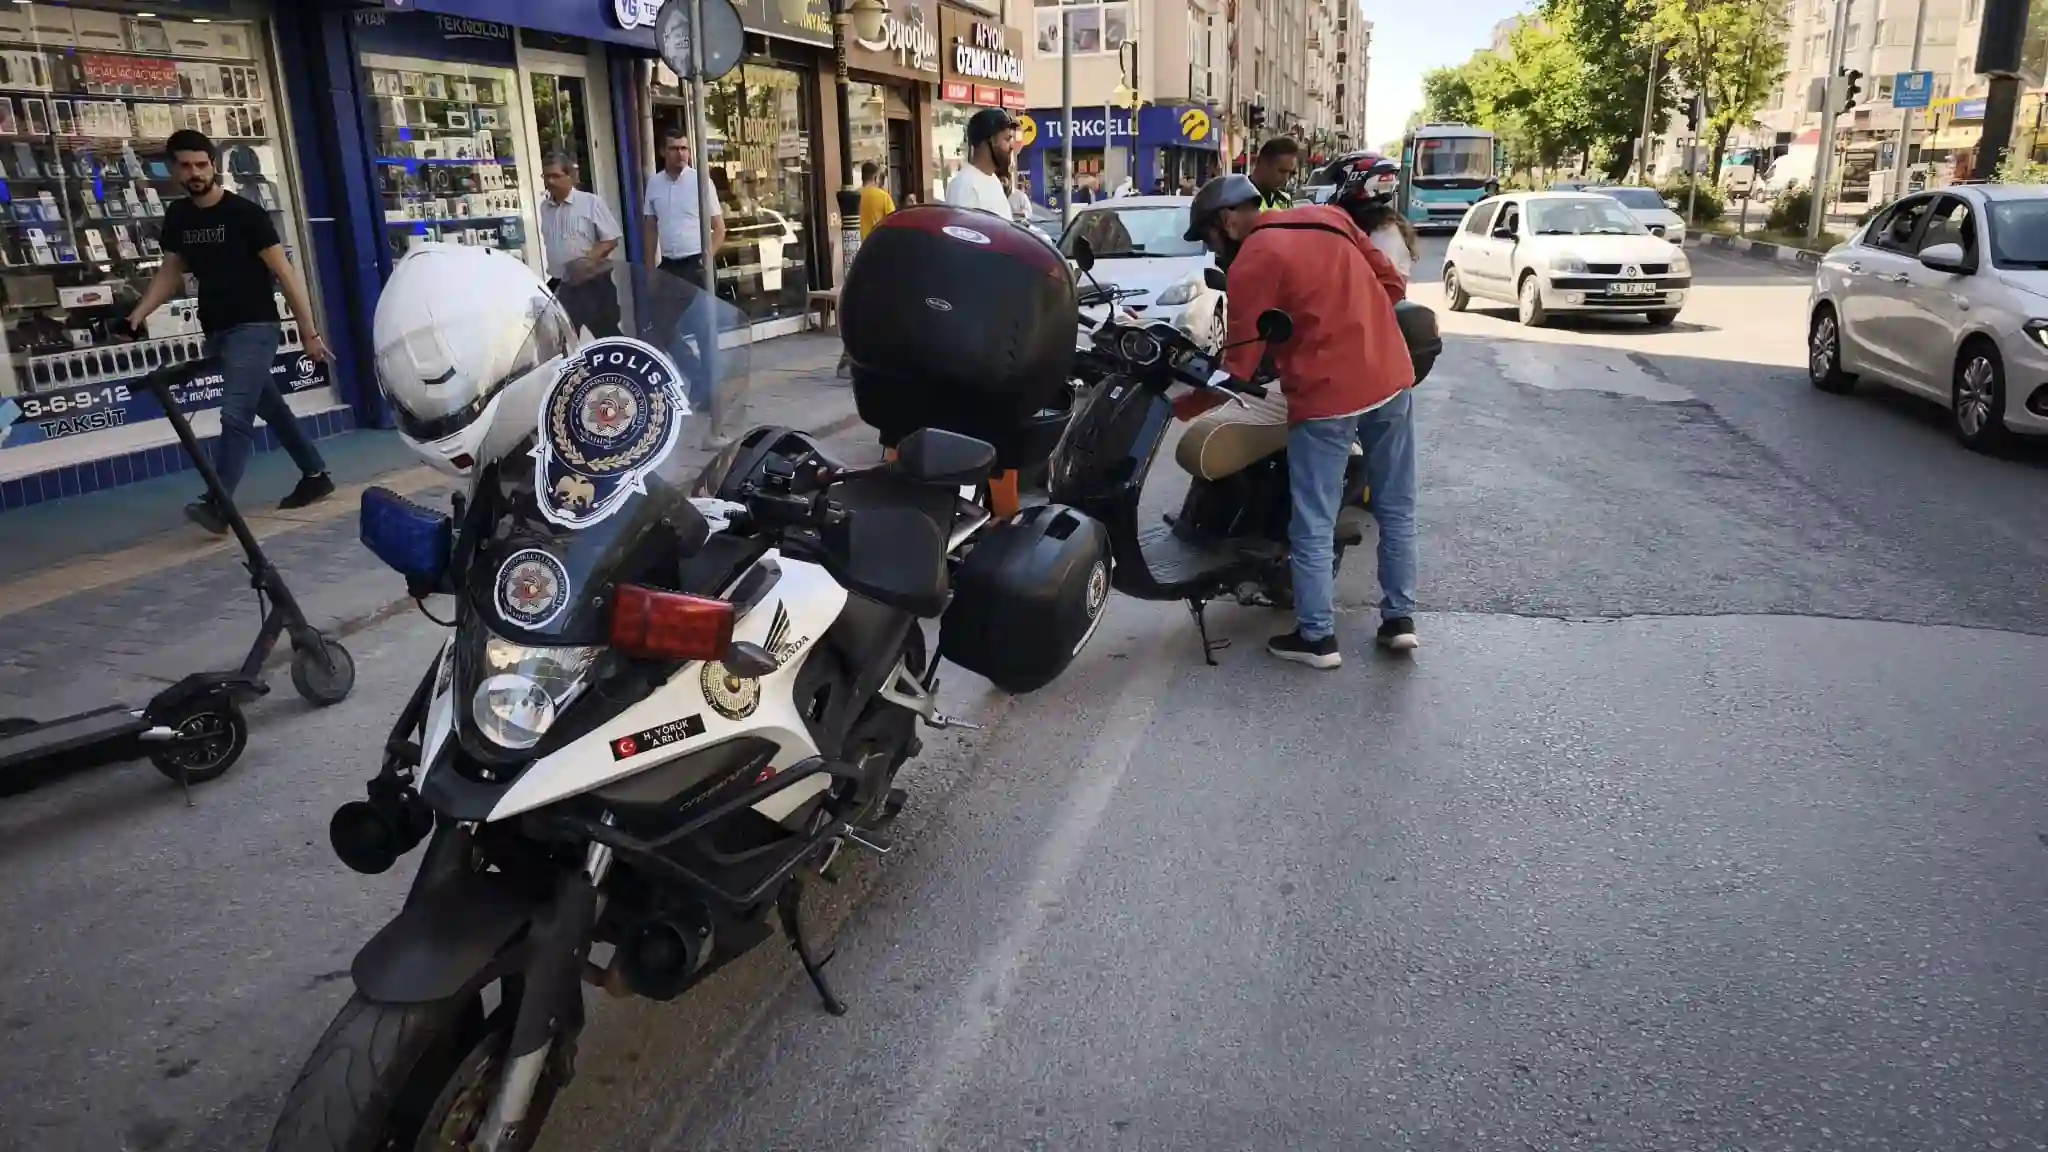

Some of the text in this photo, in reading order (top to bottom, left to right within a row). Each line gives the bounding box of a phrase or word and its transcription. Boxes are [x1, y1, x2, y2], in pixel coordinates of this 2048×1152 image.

[976, 22, 1005, 52] AFYON
[183, 224, 225, 244] mavi
[194, 374, 225, 387] WORL
[593, 352, 662, 385] POLİS
[39, 407, 127, 438] TAKSİT
[778, 635, 809, 666] ONDA
